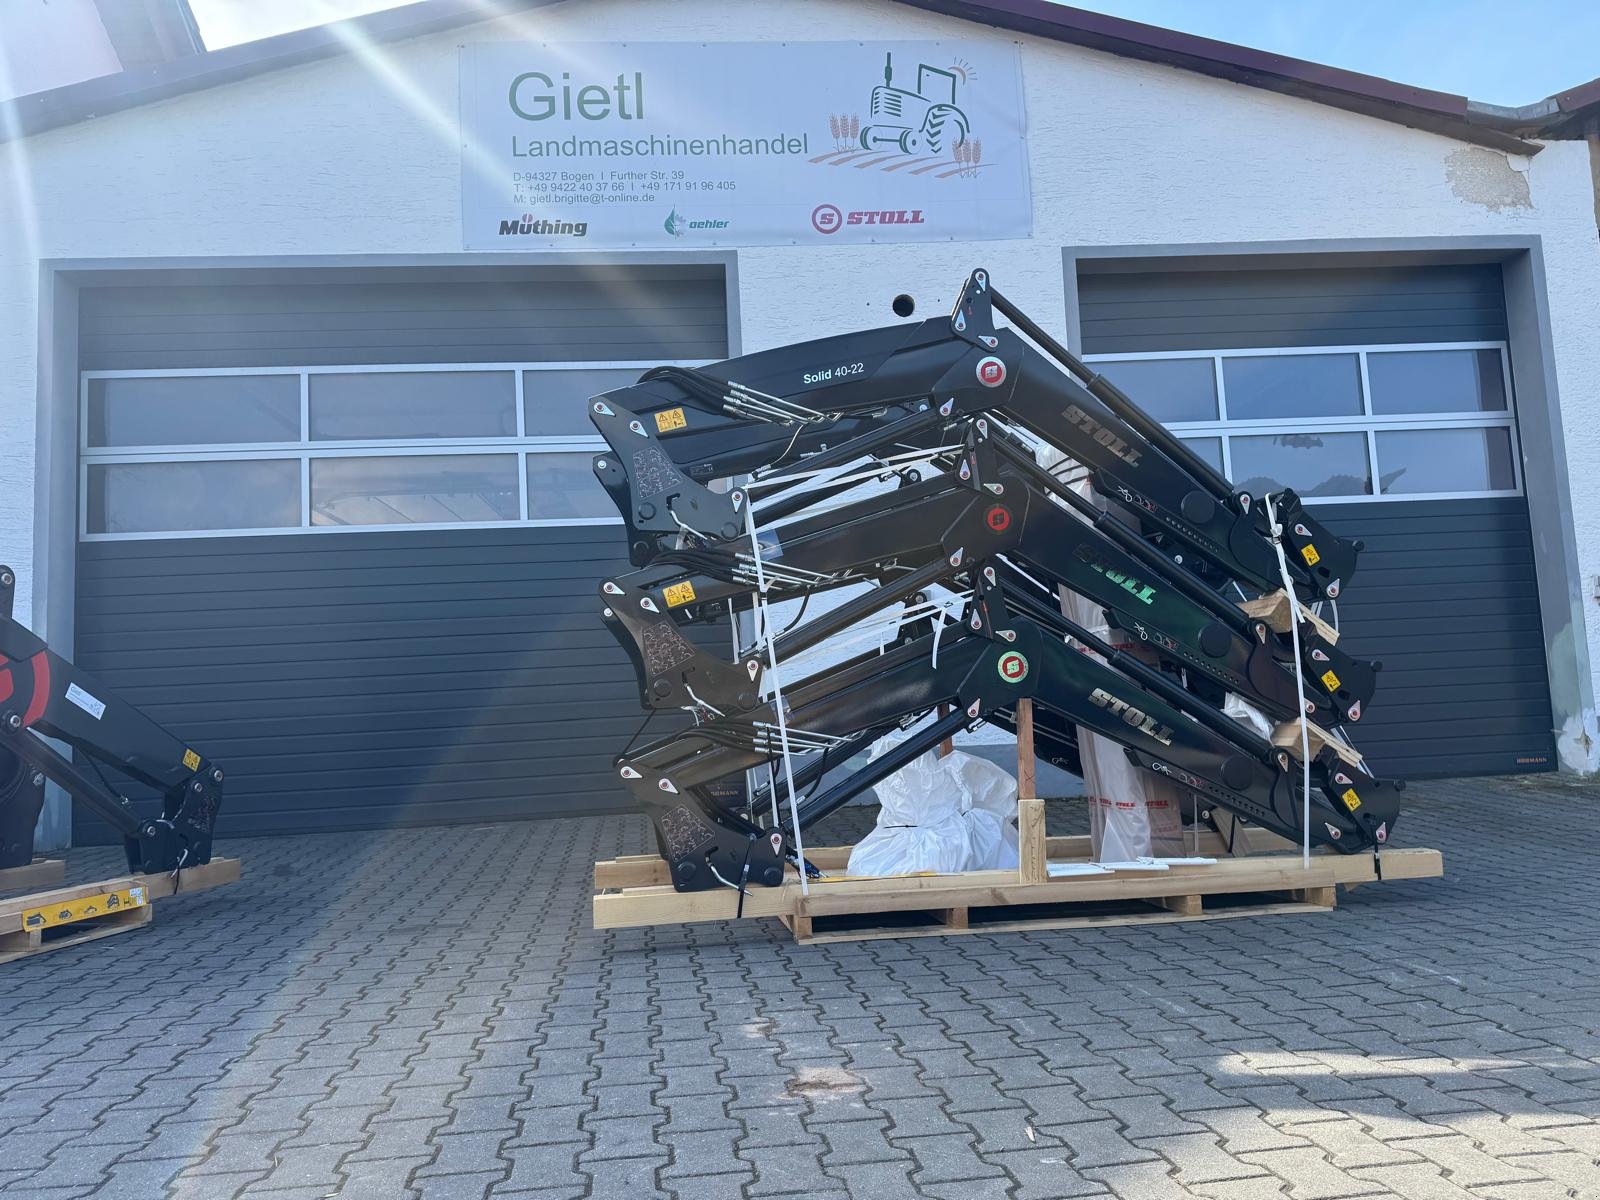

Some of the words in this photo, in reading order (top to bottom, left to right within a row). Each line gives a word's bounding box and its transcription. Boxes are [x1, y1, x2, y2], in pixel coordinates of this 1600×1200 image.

[508, 71, 644, 121] Gietl
[512, 133, 808, 158] Landmaschinenhandel
[513, 171, 558, 182] D-94327
[561, 171, 595, 183] Bogen
[610, 170, 648, 181] Further
[650, 170, 669, 180] Str.
[671, 170, 685, 180] 39
[513, 183, 525, 193] T:
[527, 182, 548, 192] +49
[550, 182, 577, 192] 9422
[579, 182, 593, 192] 40
[595, 182, 609, 192] 37
[611, 182, 625, 192] 66
[640, 181, 660, 191] +49
[664, 181, 682, 191] 171
[685, 181, 698, 191] 91
[700, 181, 714, 191] 96
[716, 180, 736, 191] 405
[513, 194, 527, 204] M:
[529, 193, 655, 205] gietl.brigitte@t-online.de
[498, 212, 588, 237] Müthing
[688, 219, 730, 229] oehler
[846, 209, 925, 225] STOLL
[803, 369, 832, 384] Solid
[834, 362, 865, 377] 40-22
[1061, 404, 1143, 468] STOLL
[1087, 687, 1175, 746] STOLL
